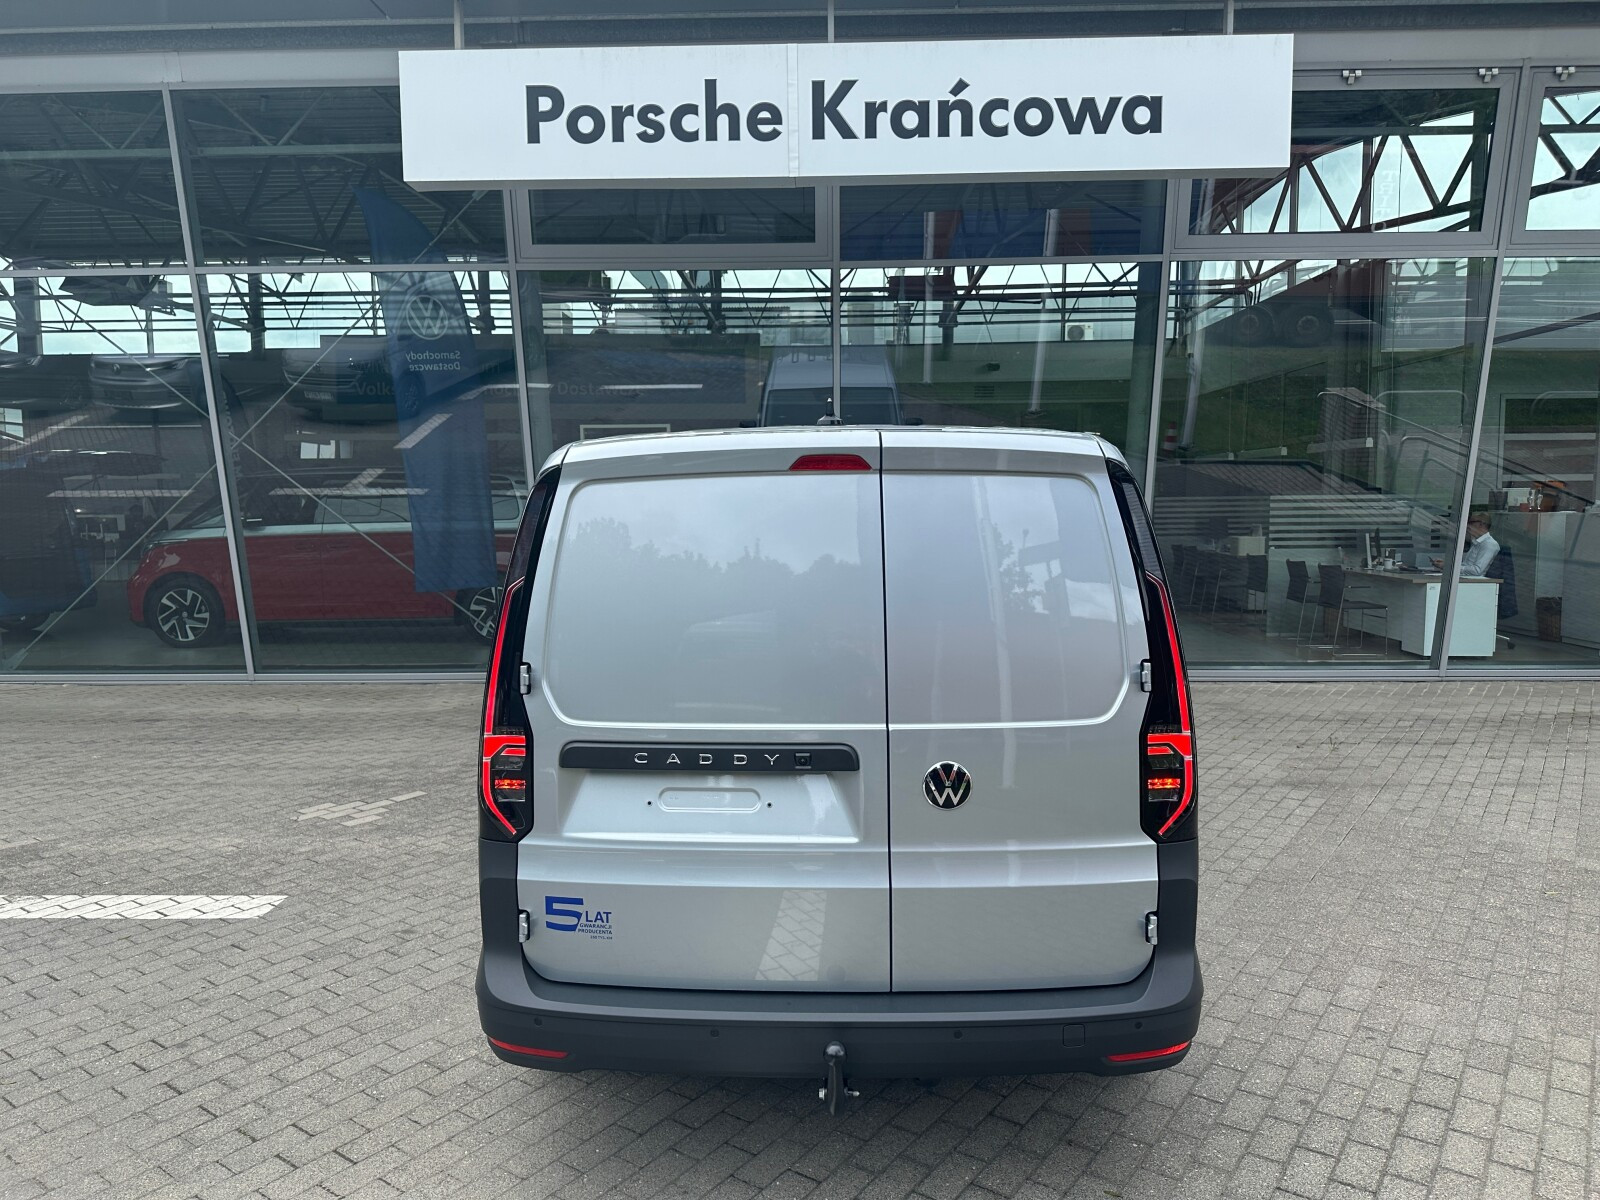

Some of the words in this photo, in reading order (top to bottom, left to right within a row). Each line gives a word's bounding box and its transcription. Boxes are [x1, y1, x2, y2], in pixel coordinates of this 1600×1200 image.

[525, 78, 783, 145] Porsche
[810, 76, 1163, 141] Krańcowa
[634, 752, 780, 765] CADDY
[545, 895, 584, 932] 5
[585, 910, 612, 923] LAT
[580, 922, 612, 930] GWARANCJI
